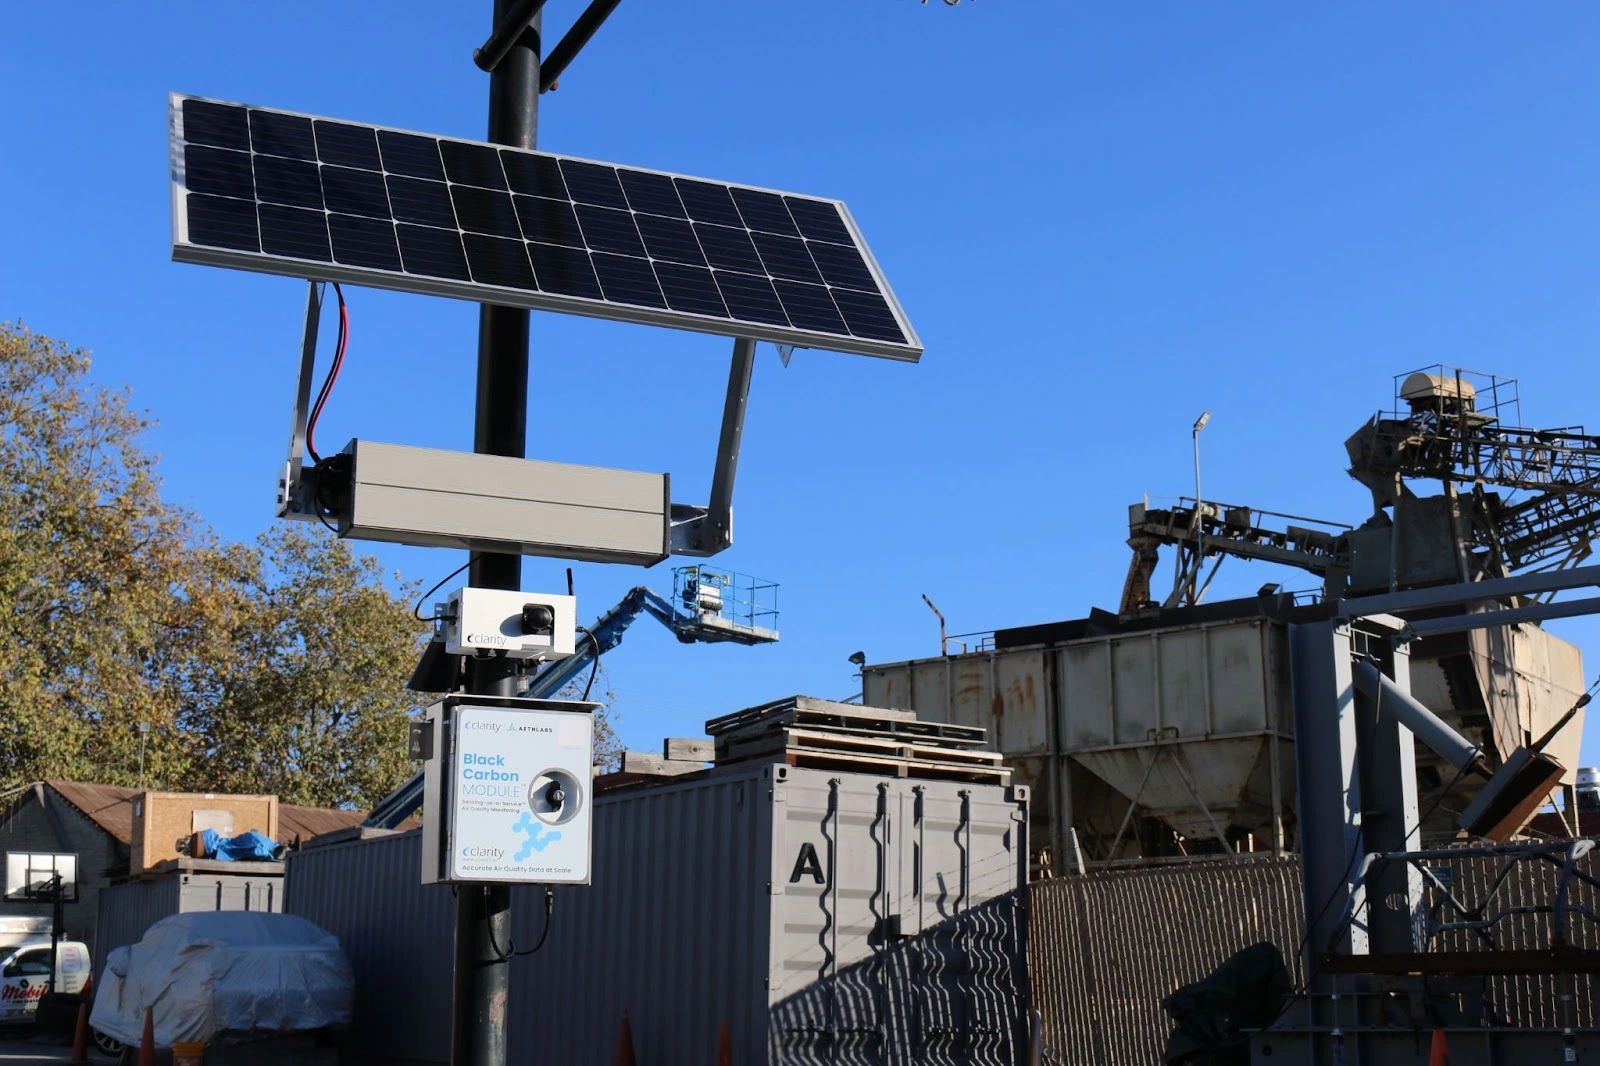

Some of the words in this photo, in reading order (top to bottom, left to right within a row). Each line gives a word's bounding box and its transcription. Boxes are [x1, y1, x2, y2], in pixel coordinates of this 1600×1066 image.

[474, 633, 507, 648] clarity
[471, 721, 502, 733] clarity
[463, 753, 505, 766] Black
[462, 768, 519, 782] Carbon
[470, 846, 505, 859] clarity
[789, 842, 826, 885] A
